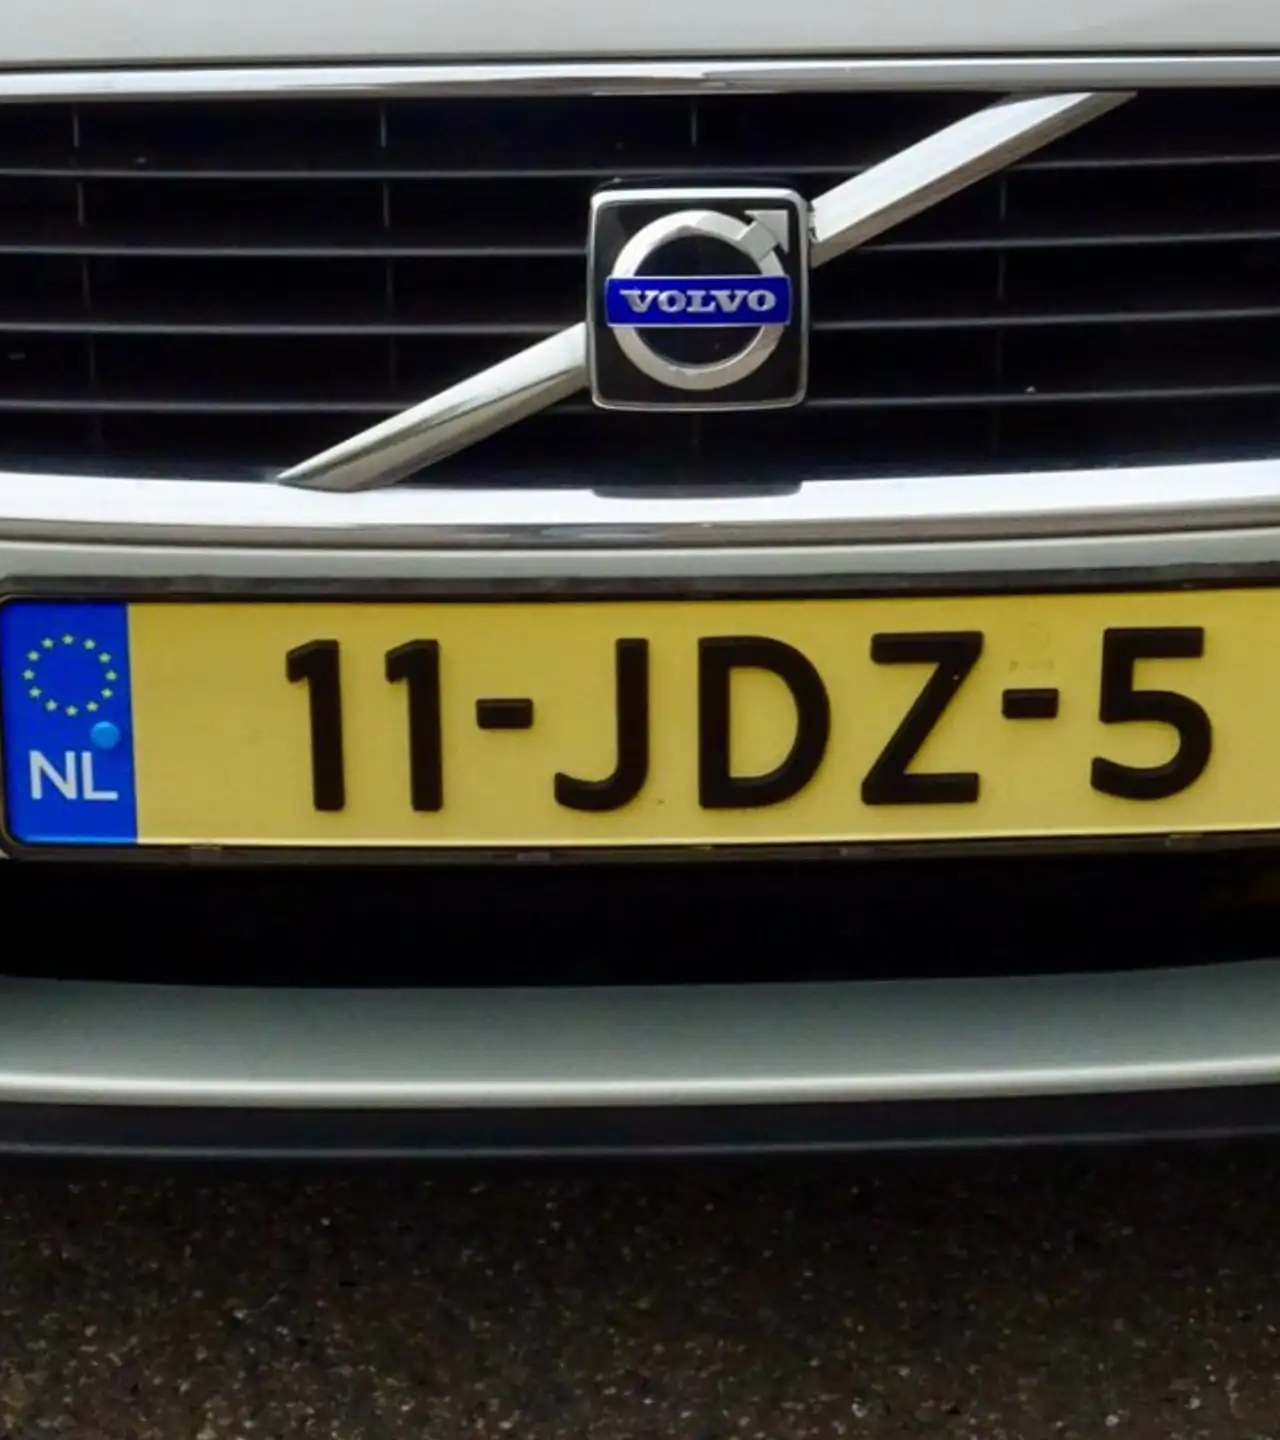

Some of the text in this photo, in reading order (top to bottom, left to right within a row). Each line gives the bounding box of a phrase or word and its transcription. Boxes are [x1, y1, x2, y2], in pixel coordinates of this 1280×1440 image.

[618, 289, 777, 313] VOLVO
[285, 626, 1213, 812] 11-JDZ-5
[29, 749, 119, 801] NL
